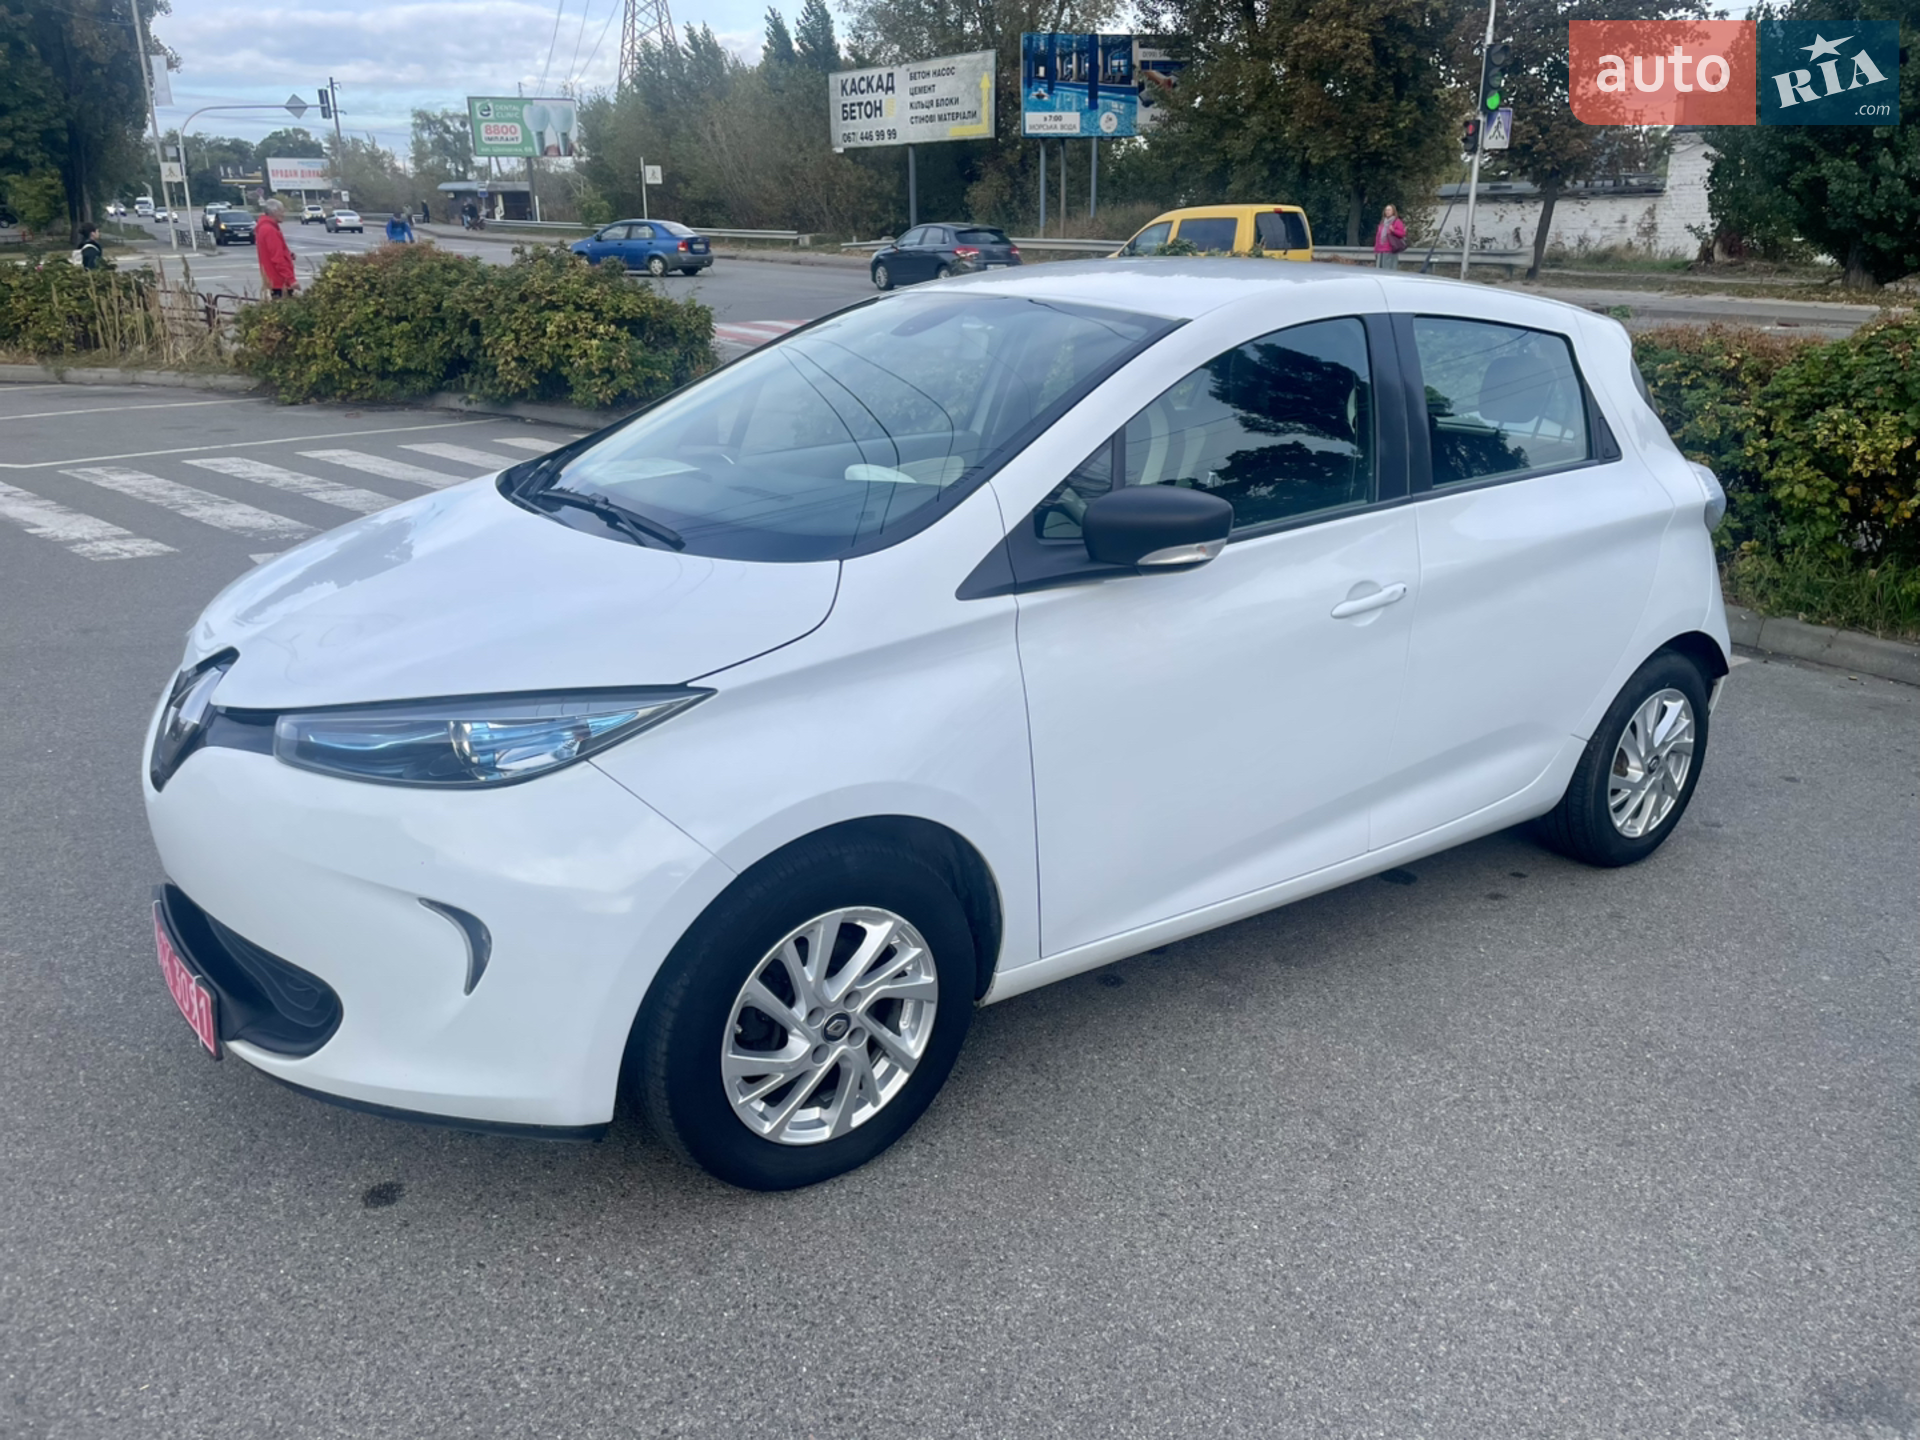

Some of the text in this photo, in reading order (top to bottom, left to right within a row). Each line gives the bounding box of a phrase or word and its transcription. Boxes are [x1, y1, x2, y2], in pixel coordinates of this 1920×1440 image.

[909, 66, 956, 81] БЕТОН НАСОС
[840, 72, 895, 97] КАСКАД
[909, 84, 936, 96] ЦЕМЕНТ
[935, 96, 960, 108] БЛОКИ
[841, 99, 883, 121] БЕТОН
[937, 110, 977, 122] МАТЕРІАЛИ
[484, 124, 518, 136] 8800
[860, 130, 873, 142] 446
[875, 129, 885, 141] 99
[887, 128, 897, 140] 99
